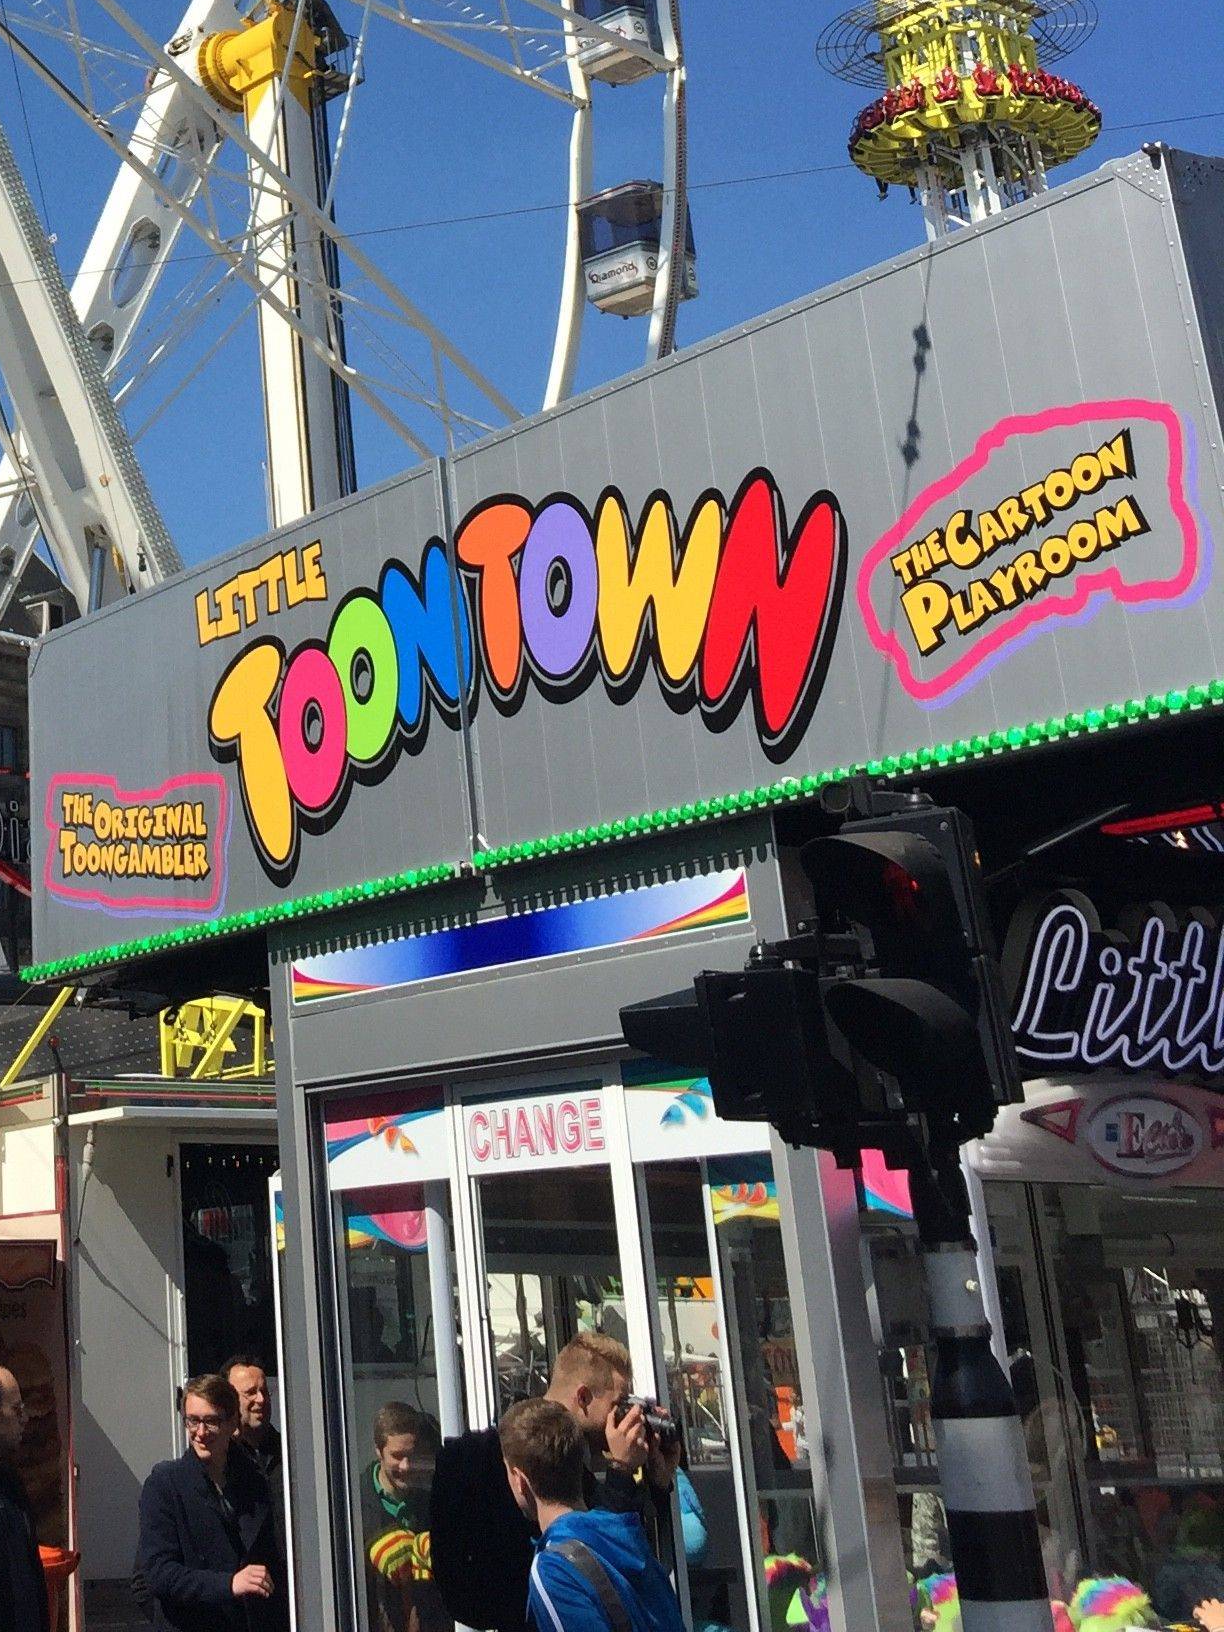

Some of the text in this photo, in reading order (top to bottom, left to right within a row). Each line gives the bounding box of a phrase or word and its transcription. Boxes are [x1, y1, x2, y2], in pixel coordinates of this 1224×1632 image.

[588, 260, 639, 285] Diamond
[890, 427, 1138, 586] THE CARTOON
[195, 539, 328, 647] LITTLE
[899, 494, 1150, 656] PLAYROOM
[61, 791, 208, 841] THE ORIGINAL
[58, 828, 210, 881] TOONGAMBLER
[469, 1096, 606, 1162] CHANGE
